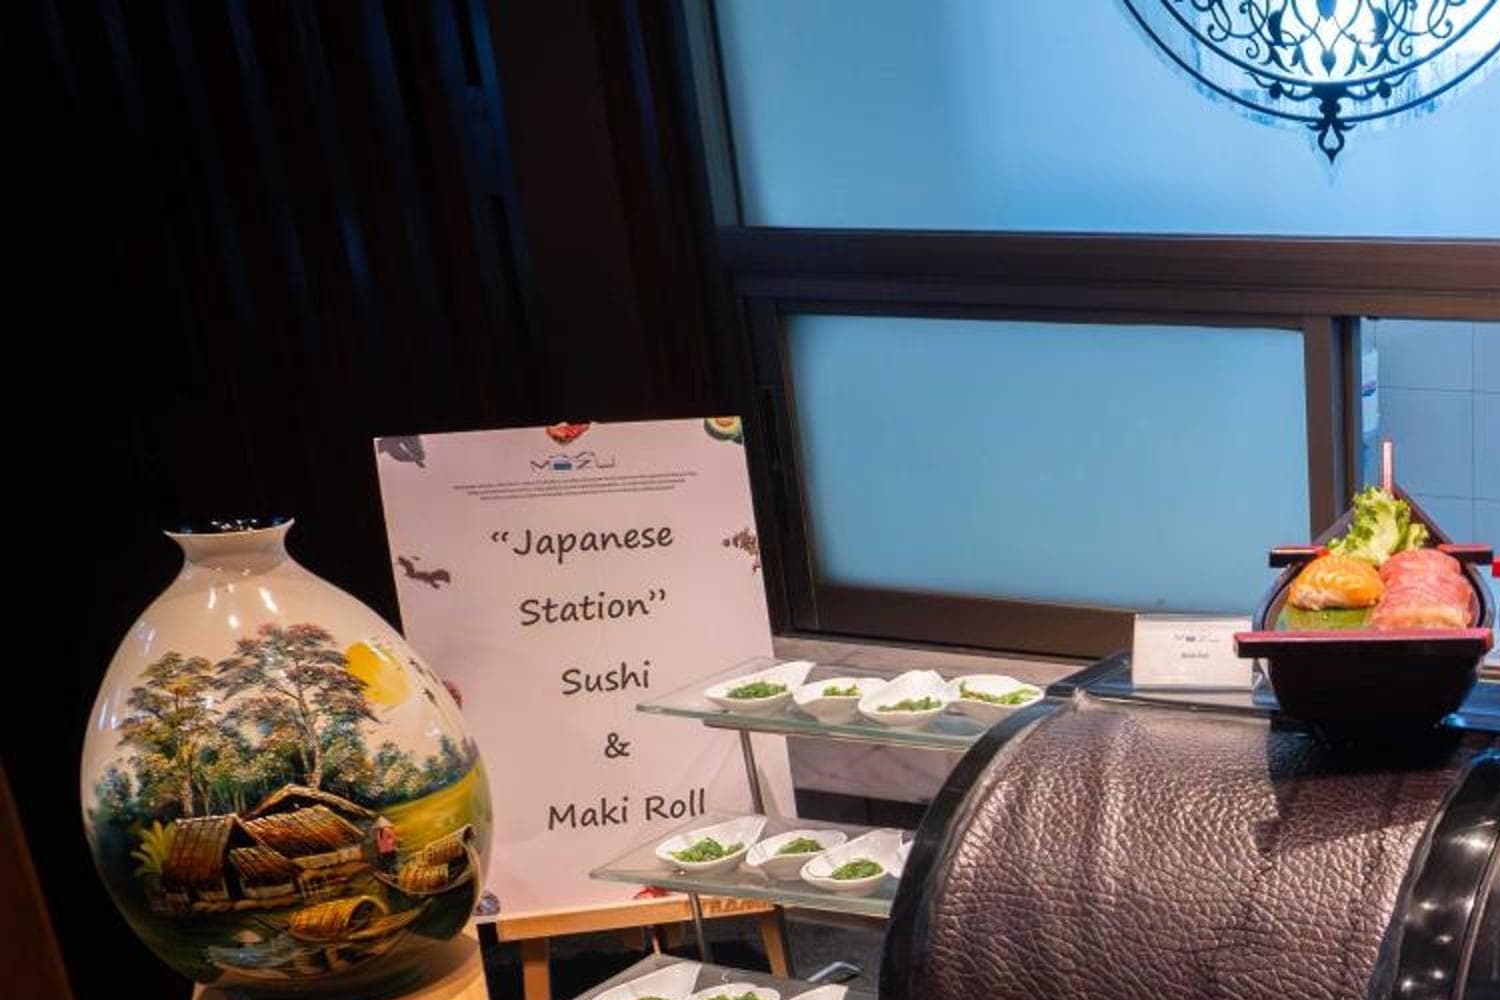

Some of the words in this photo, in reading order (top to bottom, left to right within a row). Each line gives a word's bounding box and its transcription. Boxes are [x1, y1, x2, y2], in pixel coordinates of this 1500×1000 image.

[561, 660, 651, 696] Sushi
[603, 732, 631, 760] &
[547, 796, 630, 831] Maki
[645, 787, 706, 821] Roll
